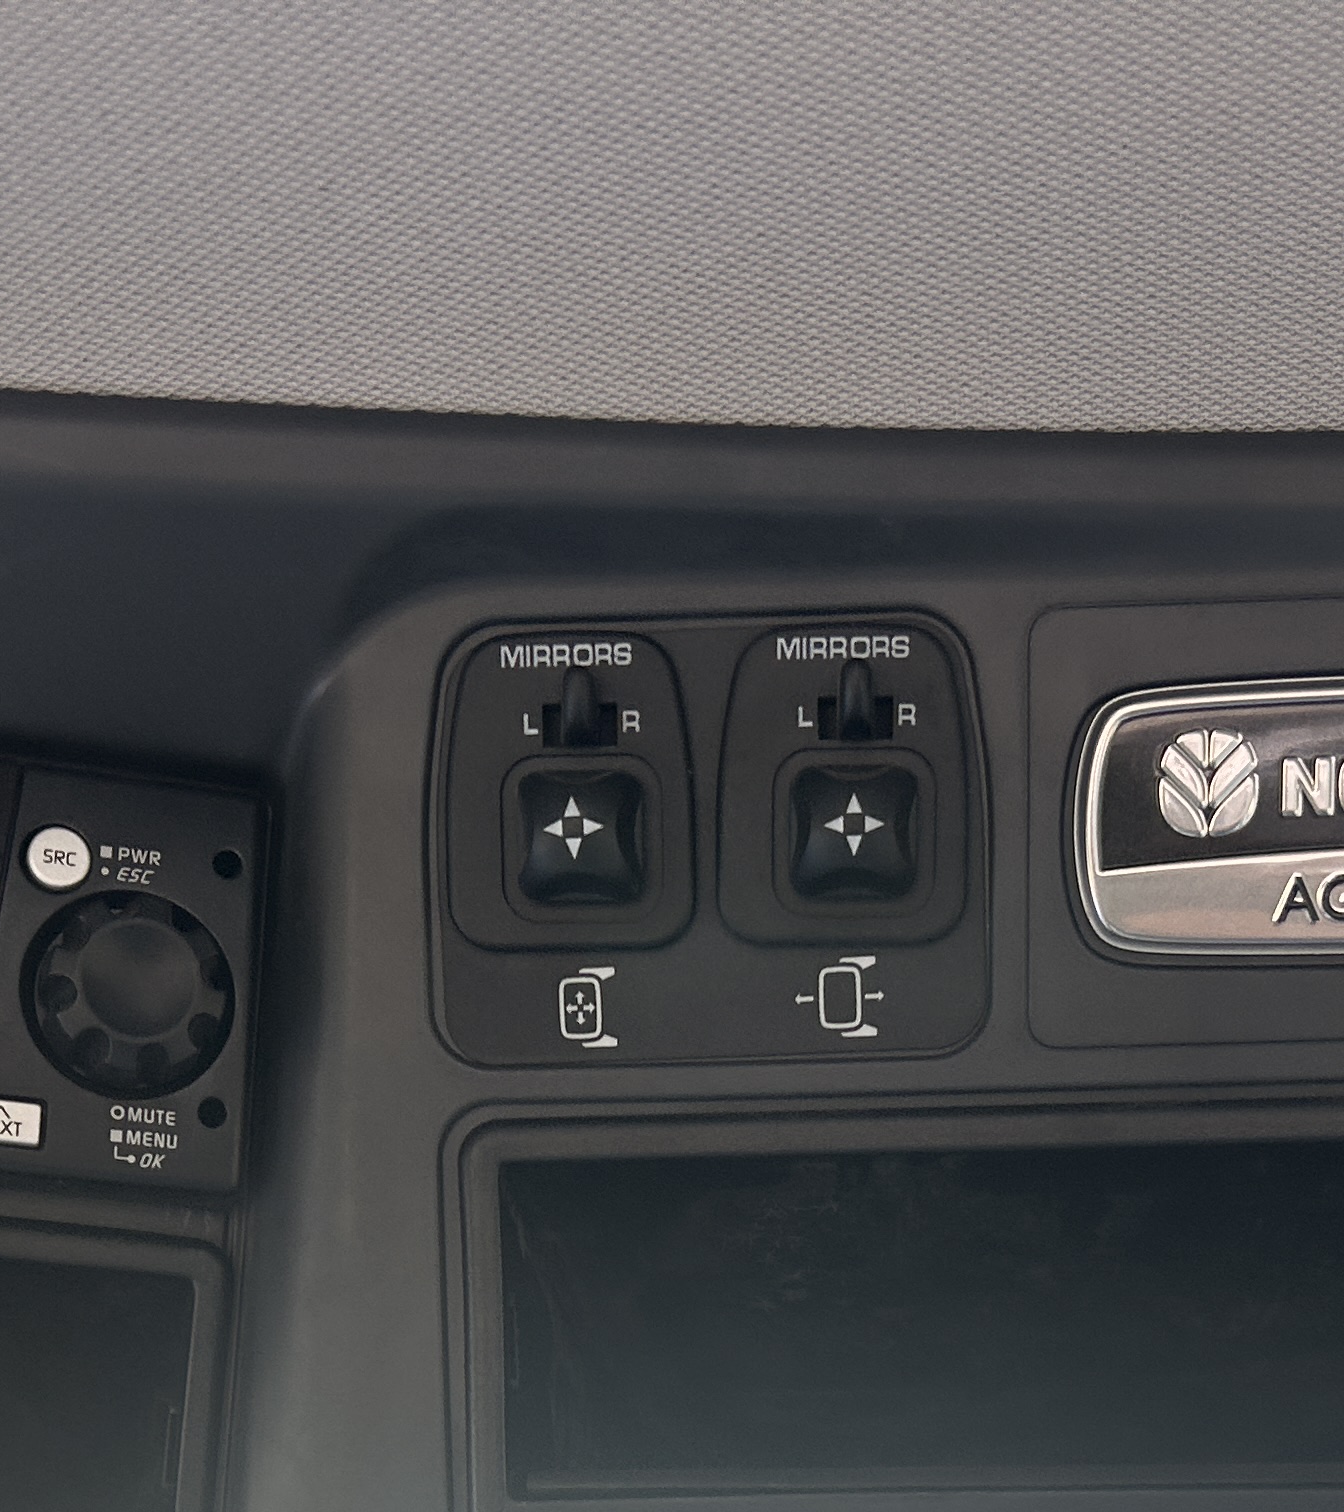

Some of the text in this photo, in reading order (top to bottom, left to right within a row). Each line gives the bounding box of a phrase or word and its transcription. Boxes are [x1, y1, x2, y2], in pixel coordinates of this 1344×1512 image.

[499, 643, 633, 669] MIRRORS
[775, 636, 911, 661] MIRRORS
[523, 713, 539, 736] L
[622, 710, 641, 733] R
[797, 707, 814, 728] L
[897, 704, 917, 727] R
[42, 848, 78, 868] SRC
[117, 846, 162, 867] PWR
[116, 867, 156, 885] ESC
[128, 1107, 177, 1127] MUTE
[125, 1130, 178, 1150] MENU
[139, 1153, 165, 1169] OK
